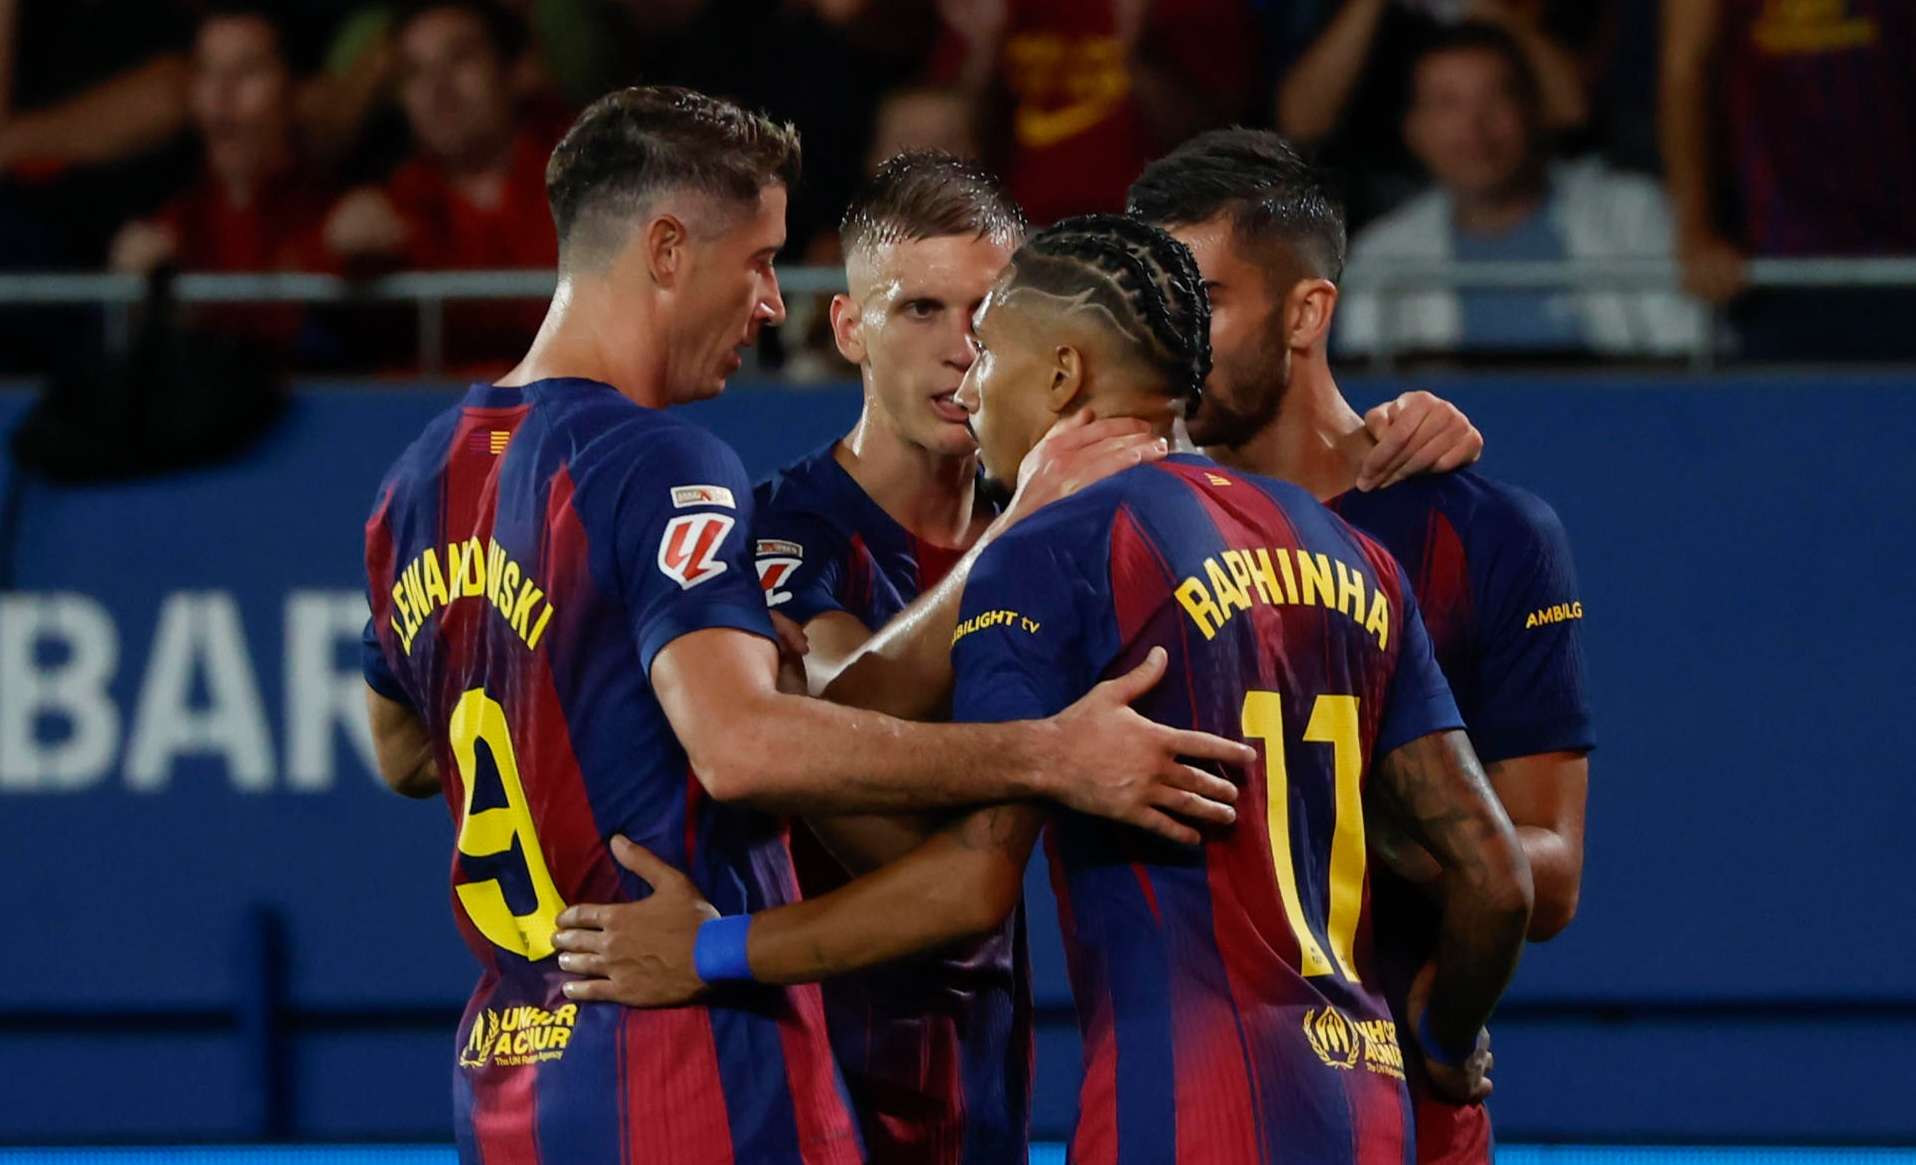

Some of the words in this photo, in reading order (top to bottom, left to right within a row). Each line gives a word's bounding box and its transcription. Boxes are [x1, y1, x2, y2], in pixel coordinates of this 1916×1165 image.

[391, 535, 554, 656] LEWANDWSKI
[1174, 547, 1389, 652] RAPHINHA
[450, 687, 568, 962] 9
[1242, 690, 1366, 982] 11
